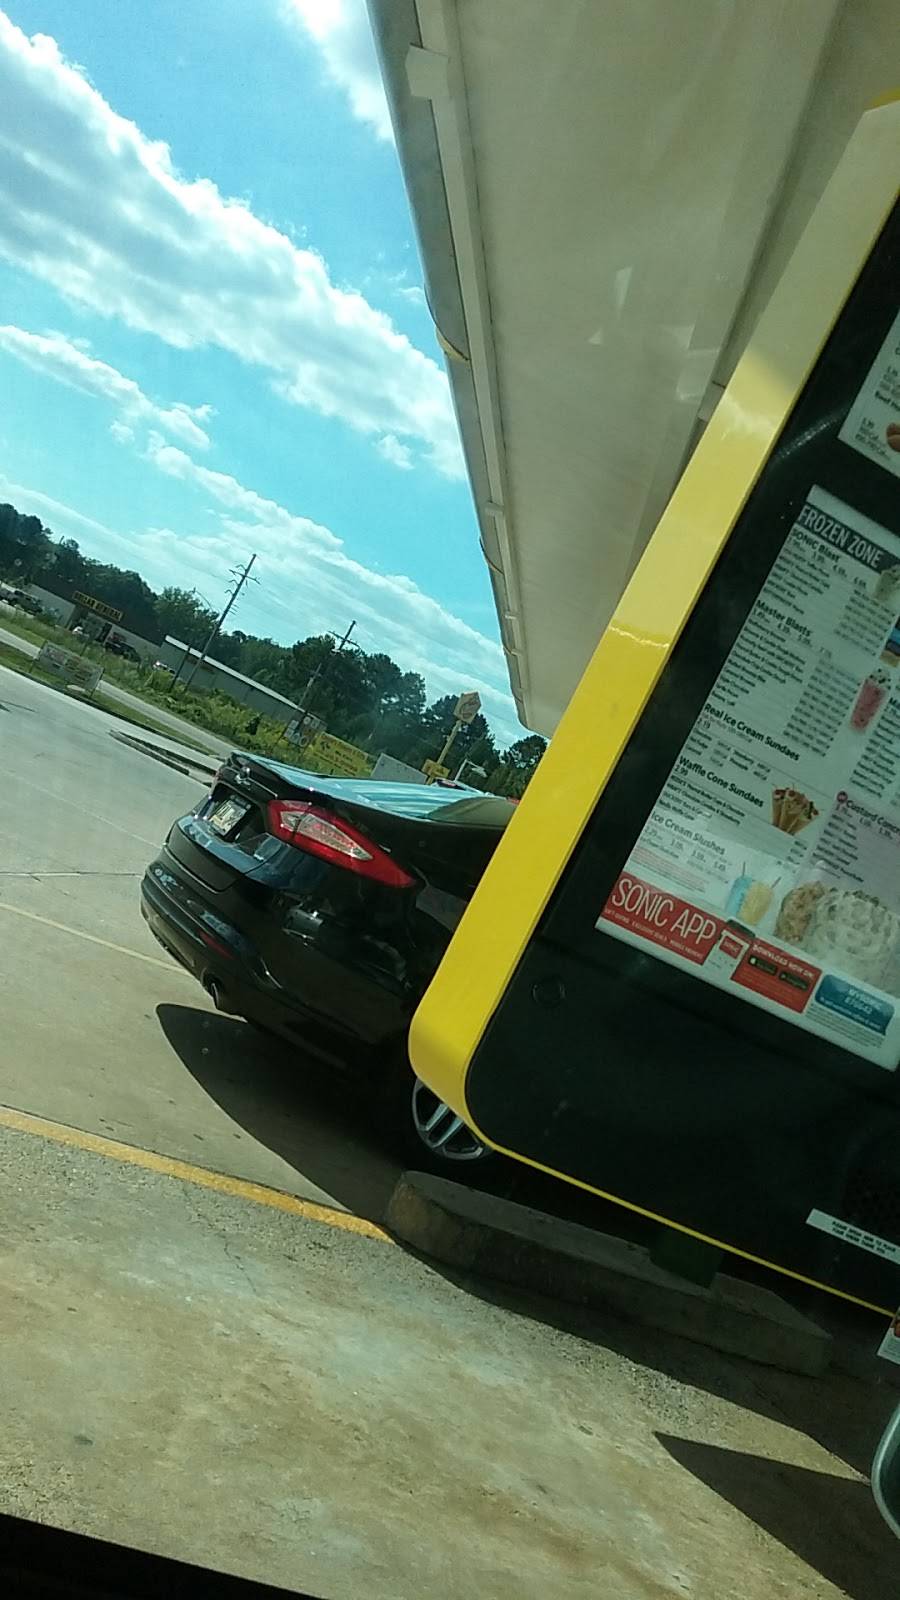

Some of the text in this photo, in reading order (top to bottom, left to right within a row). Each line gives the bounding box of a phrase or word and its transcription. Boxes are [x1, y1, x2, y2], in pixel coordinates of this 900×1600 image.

[789, 528, 819, 550] SONIC
[817, 544, 840, 563] Blast
[798, 505, 848, 546] FROZEN
[847, 536, 883, 568] ZONE
[754, 599, 785, 623] Master
[784, 616, 812, 638] Blasts
[703, 703, 723, 720] Real
[722, 714, 737, 727] Ice
[735, 721, 765, 742] Cream
[763, 736, 800, 761] Sundaes
[678, 756, 707, 777] Waffle
[705, 771, 729, 789] Cone
[727, 782, 764, 808] Sundaes
[651, 811, 726, 856] Ice Cream Slushes
[611, 878, 675, 927] SONIC
[669, 908, 717, 946] APP
